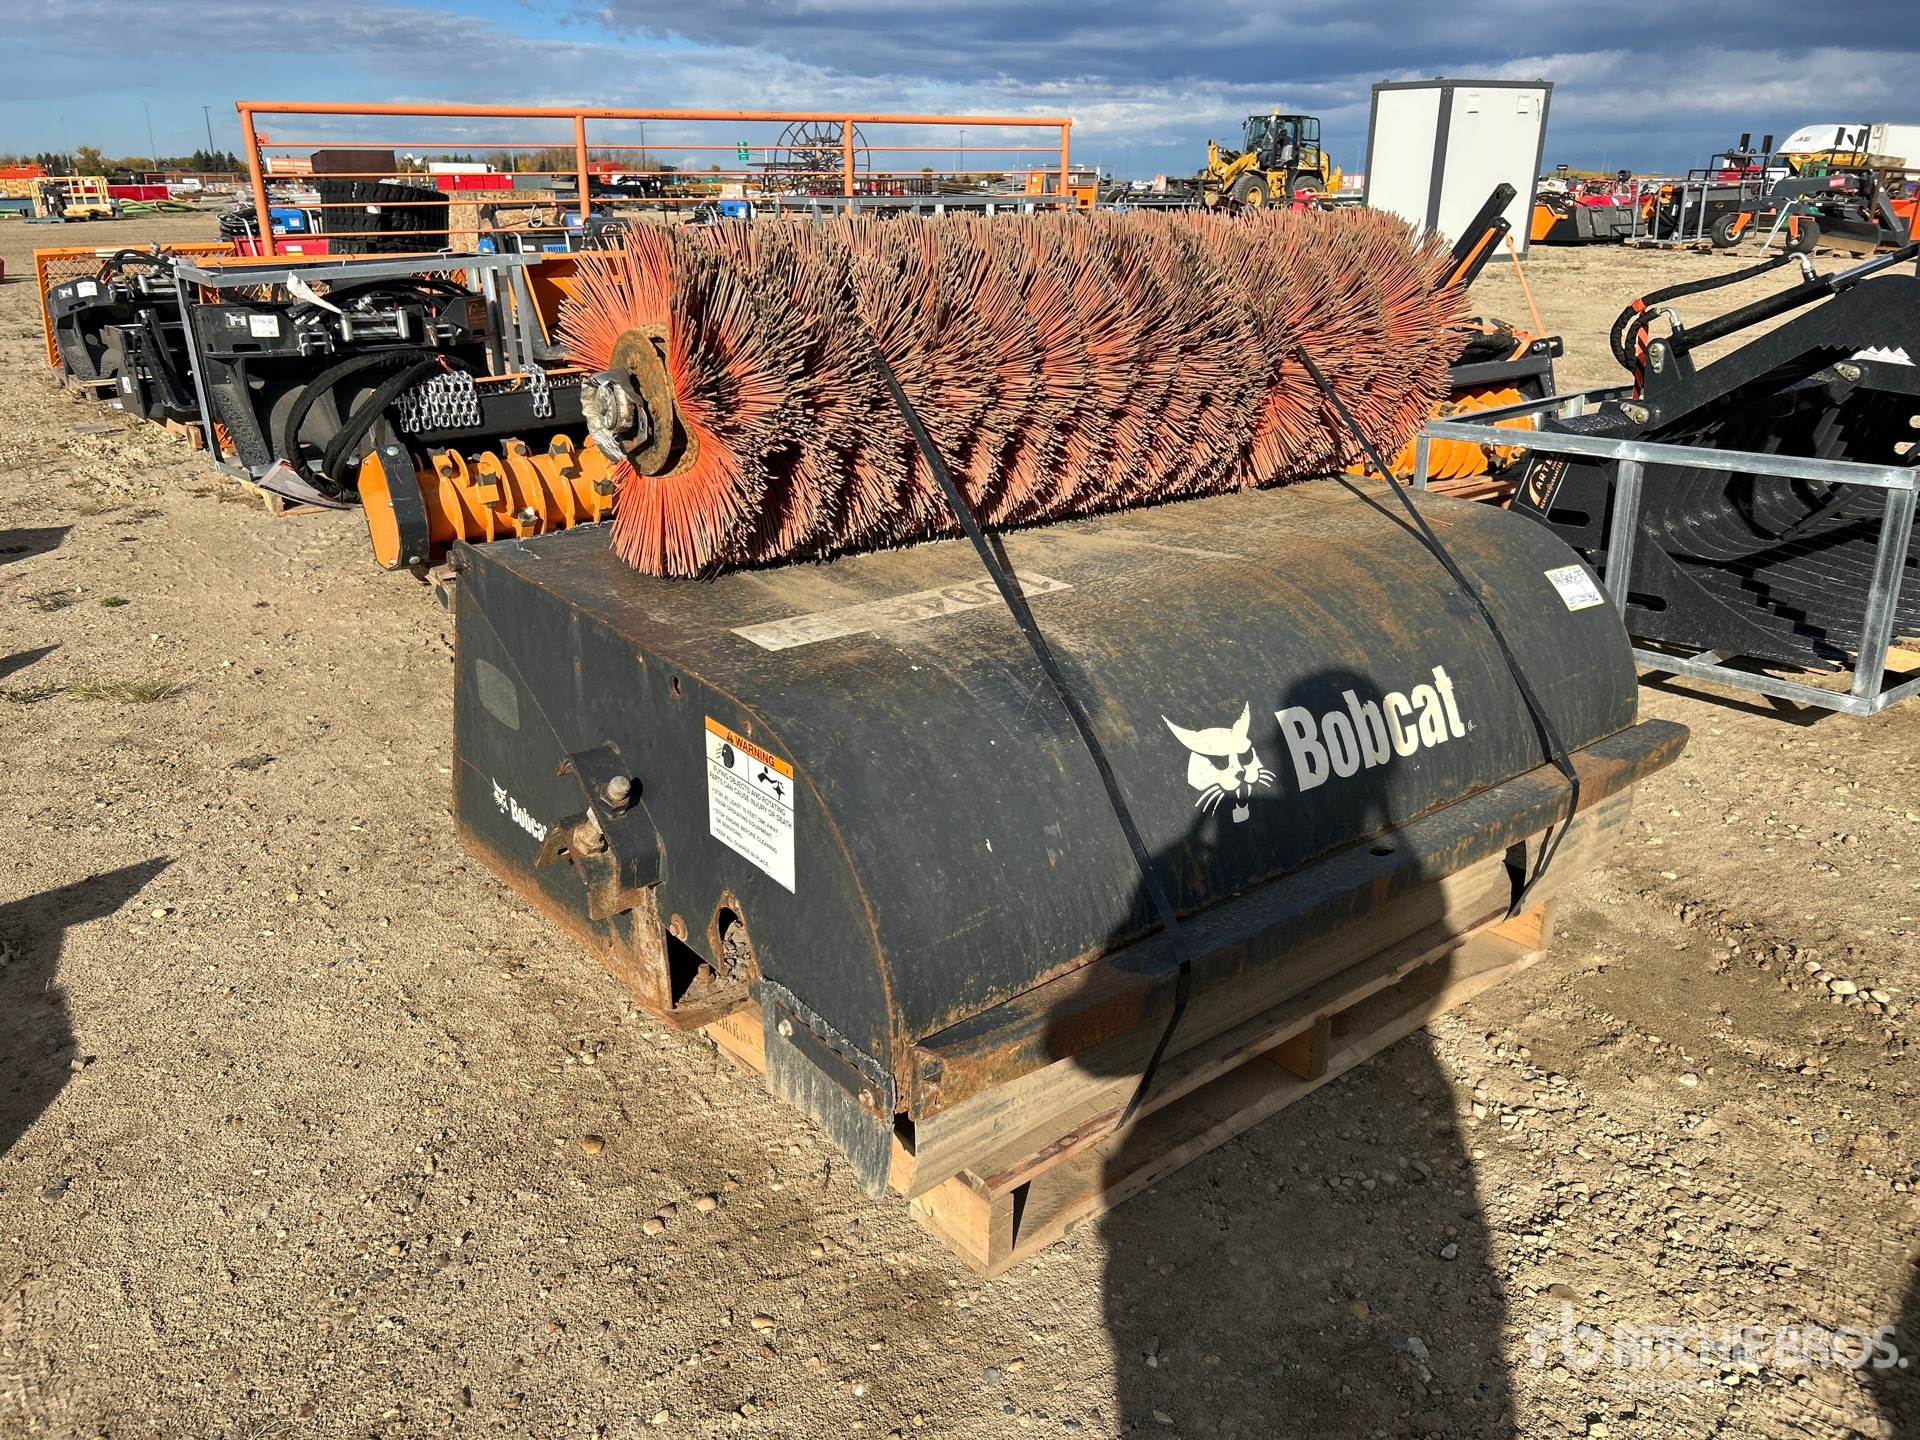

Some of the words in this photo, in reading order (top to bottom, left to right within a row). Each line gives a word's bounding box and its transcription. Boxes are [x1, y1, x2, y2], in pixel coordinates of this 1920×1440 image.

[735, 736, 775, 767] WARNING
[1275, 665, 1465, 792] Bobcat
[709, 771, 723, 785] PARTS
[724, 780, 733, 792] CAN
[734, 787, 749, 803] CAUSE
[750, 798, 767, 814] INJURY
[768, 809, 775, 819] OR
[776, 814, 793, 830] DEATH
[713, 765, 728, 780] FLYING
[729, 775, 750, 794] OBJECTS
[751, 789, 761, 801] AND
[762, 795, 786, 816] ROTATING
[726, 804, 749, 823] OPERATING
[715, 808, 725, 818] STOP
[725, 815, 740, 829] ENGINE
[740, 825, 756, 840] BEFORE
[756, 835, 778, 854] CLEANING
[716, 827, 726, 837] KEEP
[734, 840, 750, 855] GUARDS
